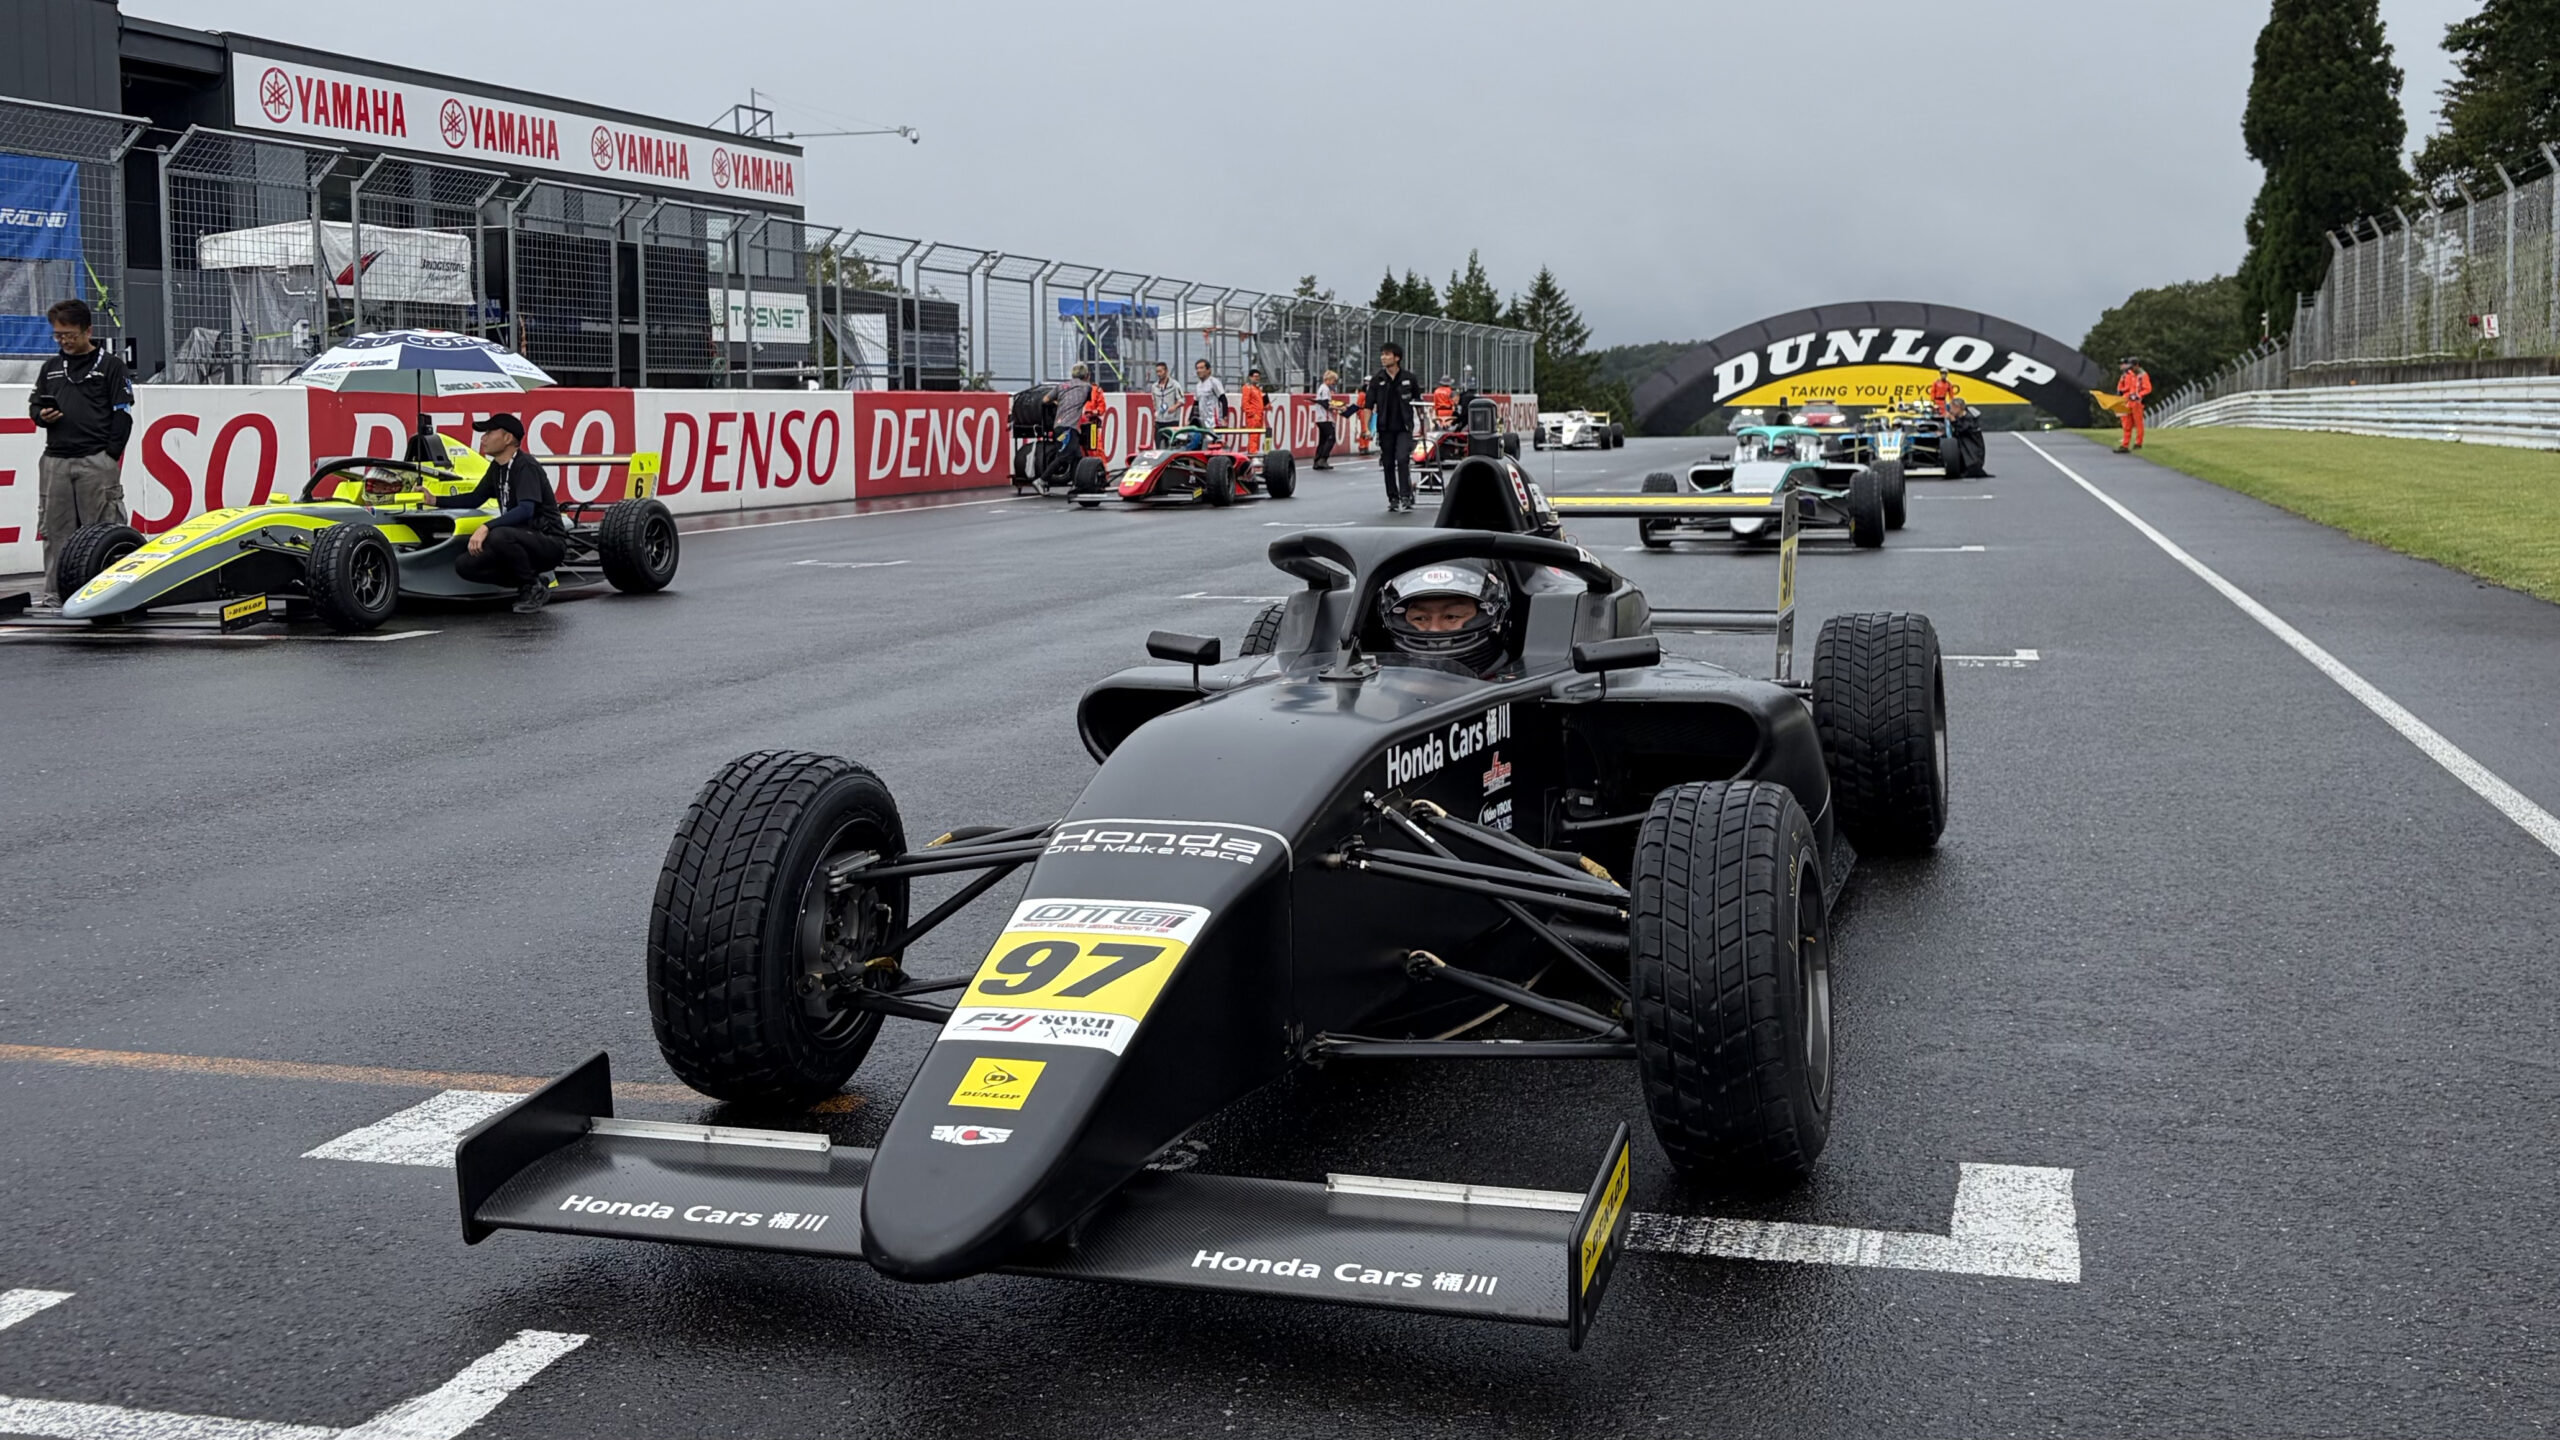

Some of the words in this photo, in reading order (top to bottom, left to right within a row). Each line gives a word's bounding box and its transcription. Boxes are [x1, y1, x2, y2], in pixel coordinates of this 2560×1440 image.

[295, 75, 407, 138] YAMAHA
[468, 105, 560, 161] YAMAHA
[614, 131, 690, 181] YAMAHA
[731, 152, 794, 197] YAMAHA
[1712, 327, 2057, 403] DUNLOP
[1790, 385, 1848, 397] TAKING
[1855, 384, 1888, 397] YOU
[656, 408, 840, 497] DENSO
[868, 406, 1000, 481] DENSO
[635, 476, 644, 499] 6
[115, 560, 146, 573] 6
[1427, 571, 1451, 580] BELL
[232, 600, 264, 616] DUNLOP
[1386, 732, 1444, 790] Honda
[1449, 722, 1484, 762] Cars
[1050, 828, 1263, 855] Honda
[1102, 843, 1176, 856] Make
[1180, 848, 1256, 865] Race
[977, 940, 1168, 998] 97
[1038, 1013, 1116, 1031] seven
[1063, 1026, 1111, 1038] seven
[960, 1090, 1022, 1100] DUNLOP
[559, 1194, 675, 1220] Honda
[683, 1205, 763, 1228] Cars
[767, 1211, 830, 1232] 桶川
[1191, 1249, 1322, 1279] Honda
[1333, 1263, 1423, 1289] Cars
[1431, 1271, 1498, 1296] 桶川
